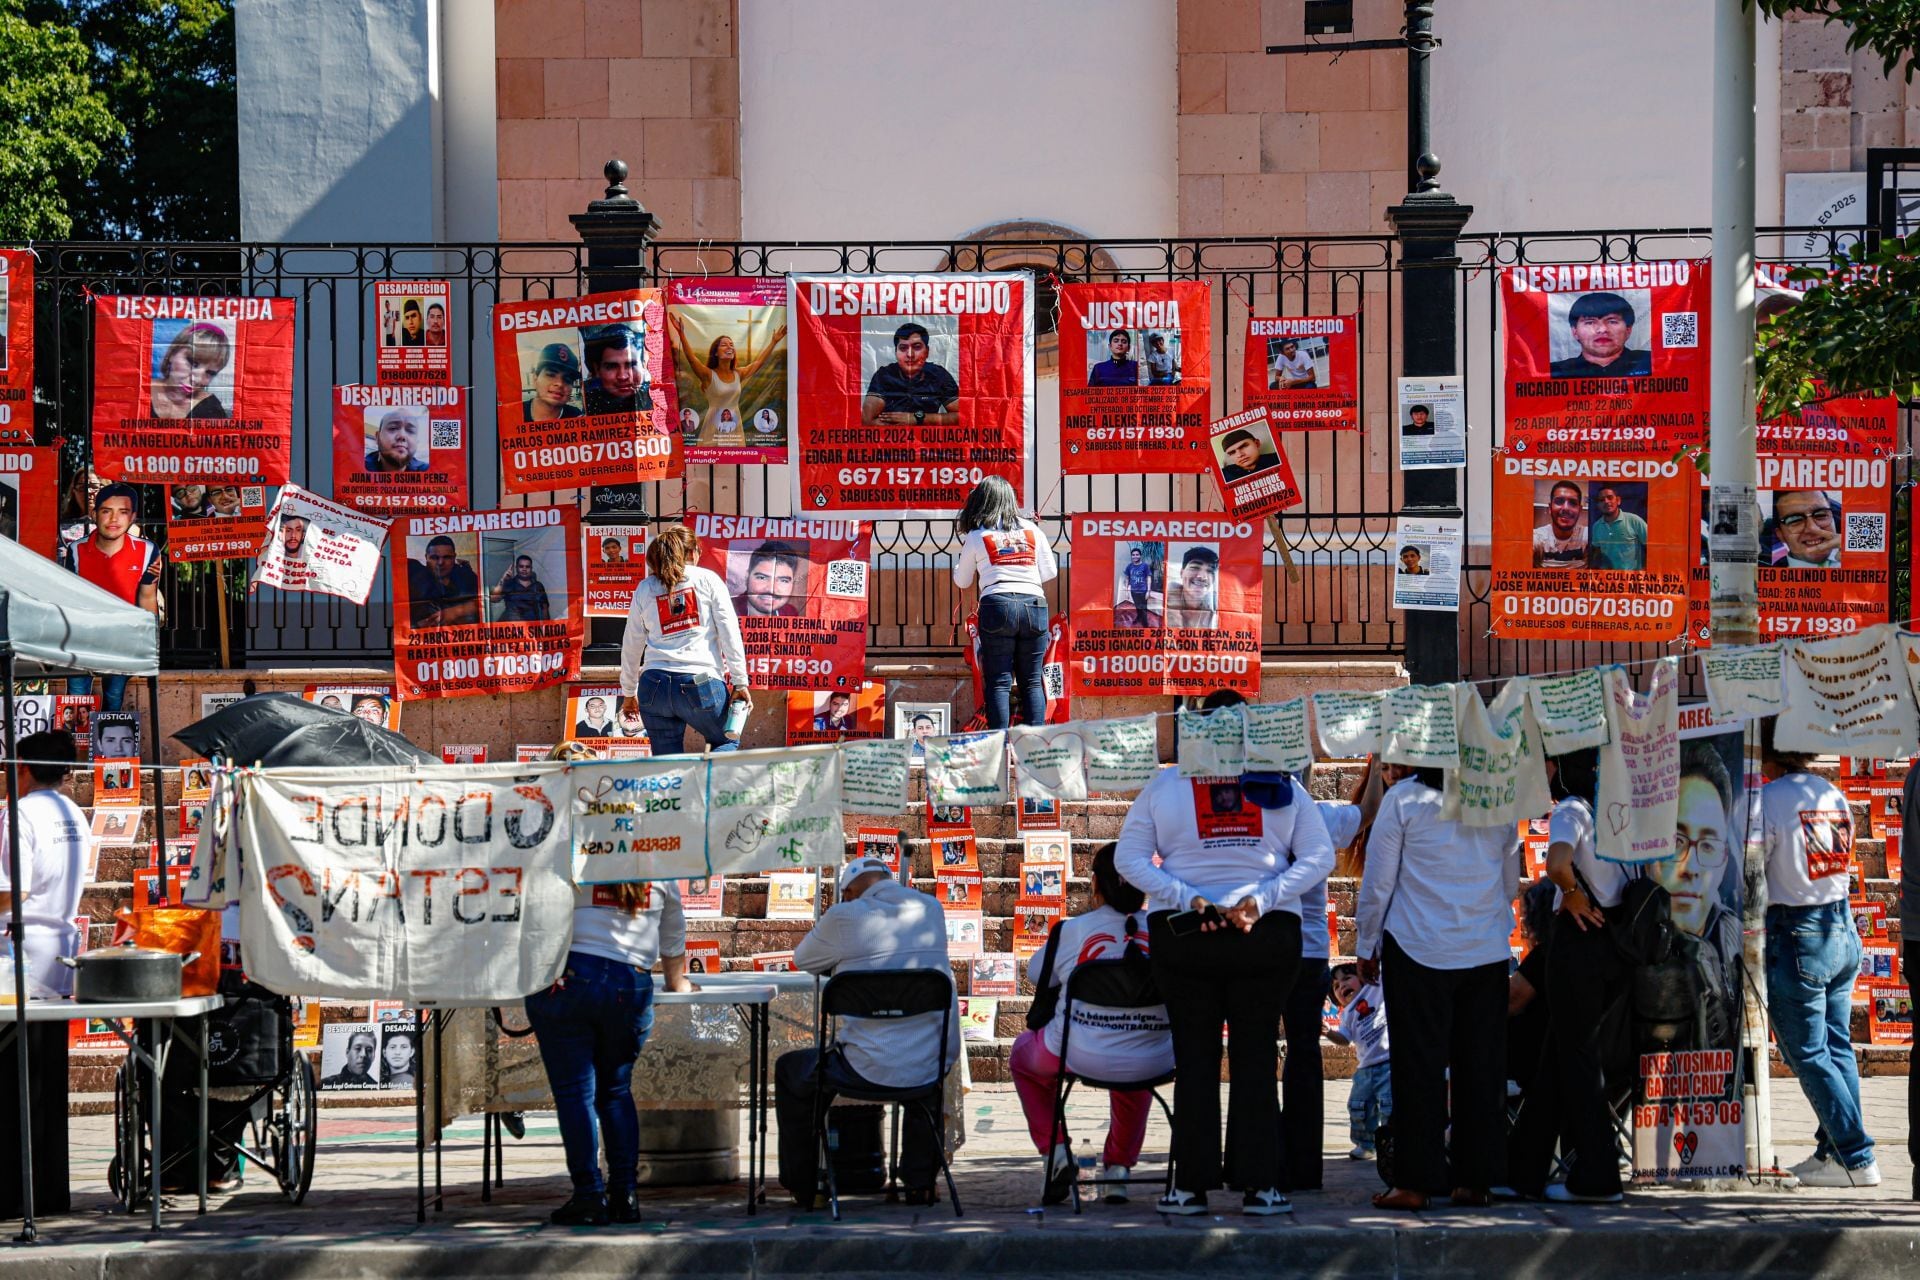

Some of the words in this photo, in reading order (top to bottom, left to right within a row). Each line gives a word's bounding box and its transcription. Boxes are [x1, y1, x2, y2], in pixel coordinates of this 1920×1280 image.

[1831, 194, 1856, 213] 2025
[1513, 260, 1689, 293] DESAPARECIDO
[379, 284, 445, 294] DESAPARECIDO
[810, 282, 1010, 315] DESAPARECIDO
[117, 297, 273, 320] DESAPARECIDA
[1080, 301, 1180, 329] JUSTICIA
[1251, 319, 1344, 335] DESAPARECIDO
[1515, 381, 1569, 398] RICARDO
[1573, 379, 1629, 395] LECHUGA
[1633, 377, 1689, 393] VERDUGO
[341, 387, 458, 406] DESAPARECIDO
[1567, 400, 1593, 412] EDAD:
[1595, 400, 1607, 410] 22
[1066, 415, 1097, 429] ANGEL
[1102, 415, 1138, 428] ALEXIS
[1140, 414, 1172, 427] ARIAS
[1176, 414, 1202, 427] ARCE
[1514, 418, 1528, 431] 28
[1531, 417, 1560, 430] ABRIL
[1565, 415, 1592, 427] 2025
[1651, 412, 1695, 426] SINALOA
[1840, 416, 1886, 430] SINALOA
[503, 436, 542, 450] CARLOS
[546, 432, 578, 443] OMAR
[582, 427, 630, 440] RAMIREZ
[810, 430, 824, 444] 24
[828, 430, 880, 444] FEBRERO
[884, 430, 915, 443] 2024
[1087, 428, 1116, 440] 667
[1119, 427, 1145, 439] 157
[1148, 427, 1184, 439] 1930
[1546, 427, 1656, 441] 6671571930
[104, 434, 128, 447] ANA
[132, 434, 190, 448] ANGELICA
[223, 435, 280, 449] REYNOSO
[1085, 441, 1121, 451] SABUESOS
[514, 438, 671, 469] 018006703600
[806, 450, 843, 464] EDGAR
[847, 449, 916, 463] ALEJANDRO
[920, 449, 965, 462] RANGEL
[970, 449, 1017, 462] MACIAS
[124, 456, 143, 472] 01
[147, 456, 179, 473] 800
[184, 456, 259, 474] 6703600
[1504, 458, 1678, 479] DESAPARECIDO
[350, 473, 371, 483] JUAN
[374, 474, 391, 483] LUIS
[395, 474, 421, 483] OSUNA
[424, 474, 448, 483] PEREZ
[838, 468, 882, 485] 667
[887, 468, 925, 485] 157
[930, 467, 984, 484] 1930
[1234, 483, 1250, 496] LUIS
[1251, 473, 1280, 491] ENRIQUE
[356, 496, 382, 506] 667
[385, 496, 409, 506] 157
[412, 496, 446, 506] 1930
[1235, 493, 1264, 506] ACOSTA
[1263, 481, 1286, 497] ELISEO
[410, 509, 561, 535] DESAPARECIDO
[695, 515, 859, 541] DESAPARECIDO
[1083, 520, 1252, 538] DESAPARECIDO
[590, 528, 642, 536] DESAPARECIDO
[185, 544, 205, 552] 667
[207, 542, 224, 551] 157
[226, 541, 251, 549] 1930
[1780, 570, 1827, 583] GALINDO
[1830, 570, 1887, 583] GUTIERREZ
[589, 591, 610, 599] NOS
[614, 591, 635, 599] FALT
[1493, 581, 1522, 592] JOSE
[1526, 581, 1575, 593] MANUEL
[1579, 582, 1625, 593] MACIAS
[1628, 583, 1685, 595] MENDOZA
[1785, 588, 1796, 598] 26
[1504, 596, 1673, 618] 018006703600
[1769, 602, 1799, 613] PALMA
[1801, 602, 1847, 613] NAVOLATO
[1850, 603, 1885, 613] SINALOA
[745, 618, 788, 628] ADELAIDO
[792, 619, 827, 630] BERNAL
[831, 621, 864, 633] VALDEZ
[1515, 619, 1566, 629] SABUESOS
[1766, 617, 1801, 632] 157
[1806, 617, 1856, 633] 1930
[409, 634, 420, 645] 23
[423, 632, 450, 644] ABRIL
[452, 629, 475, 642] 2021
[529, 624, 566, 637] SINALOA
[747, 632, 768, 642] 2018
[772, 633, 782, 643] EL
[784, 633, 837, 644] TAMARINDO
[408, 648, 449, 660] RAFAEL
[452, 643, 519, 656] HERNANDEZ
[523, 639, 571, 651] NIEBLAS
[1072, 640, 1105, 651] JESUS
[1109, 640, 1152, 651] IGNACIO
[1155, 640, 1198, 651] ARAGON
[1202, 640, 1258, 653] RETAMOZA
[418, 661, 438, 681] 01
[443, 658, 478, 679] 800
[483, 652, 563, 676] 6703600
[748, 658, 782, 674] 157
[786, 659, 832, 674] 1930
[1083, 655, 1248, 674] 018006703600
[317, 686, 390, 694] DESAPARECIDO
[581, 688, 624, 696] DESAPAR
[61, 696, 94, 704] JUSTICIA
[444, 746, 484, 755] DESAPARECIDO
[933, 835, 973, 843] DESAPARECIDO
[1022, 864, 1064, 872] DESAPARECIDO
[938, 875, 981, 884] DESAPARECIDO
[1015, 906, 1060, 916] DESAPARECIDA
[685, 948, 718, 956] APARECIDA
[1862, 946, 1896, 956] APARECIDO
[1872, 988, 1910, 998] DESAPARECI
[1640, 1052, 1674, 1077] REYES
[1675, 1050, 1733, 1074] YOSIMAR
[1647, 1074, 1689, 1099] GARCIA
[1692, 1073, 1725, 1096] CRUZ
[1634, 1105, 1669, 1128] 6674
[1692, 1102, 1716, 1126] 53
[1718, 1101, 1742, 1125] 08
